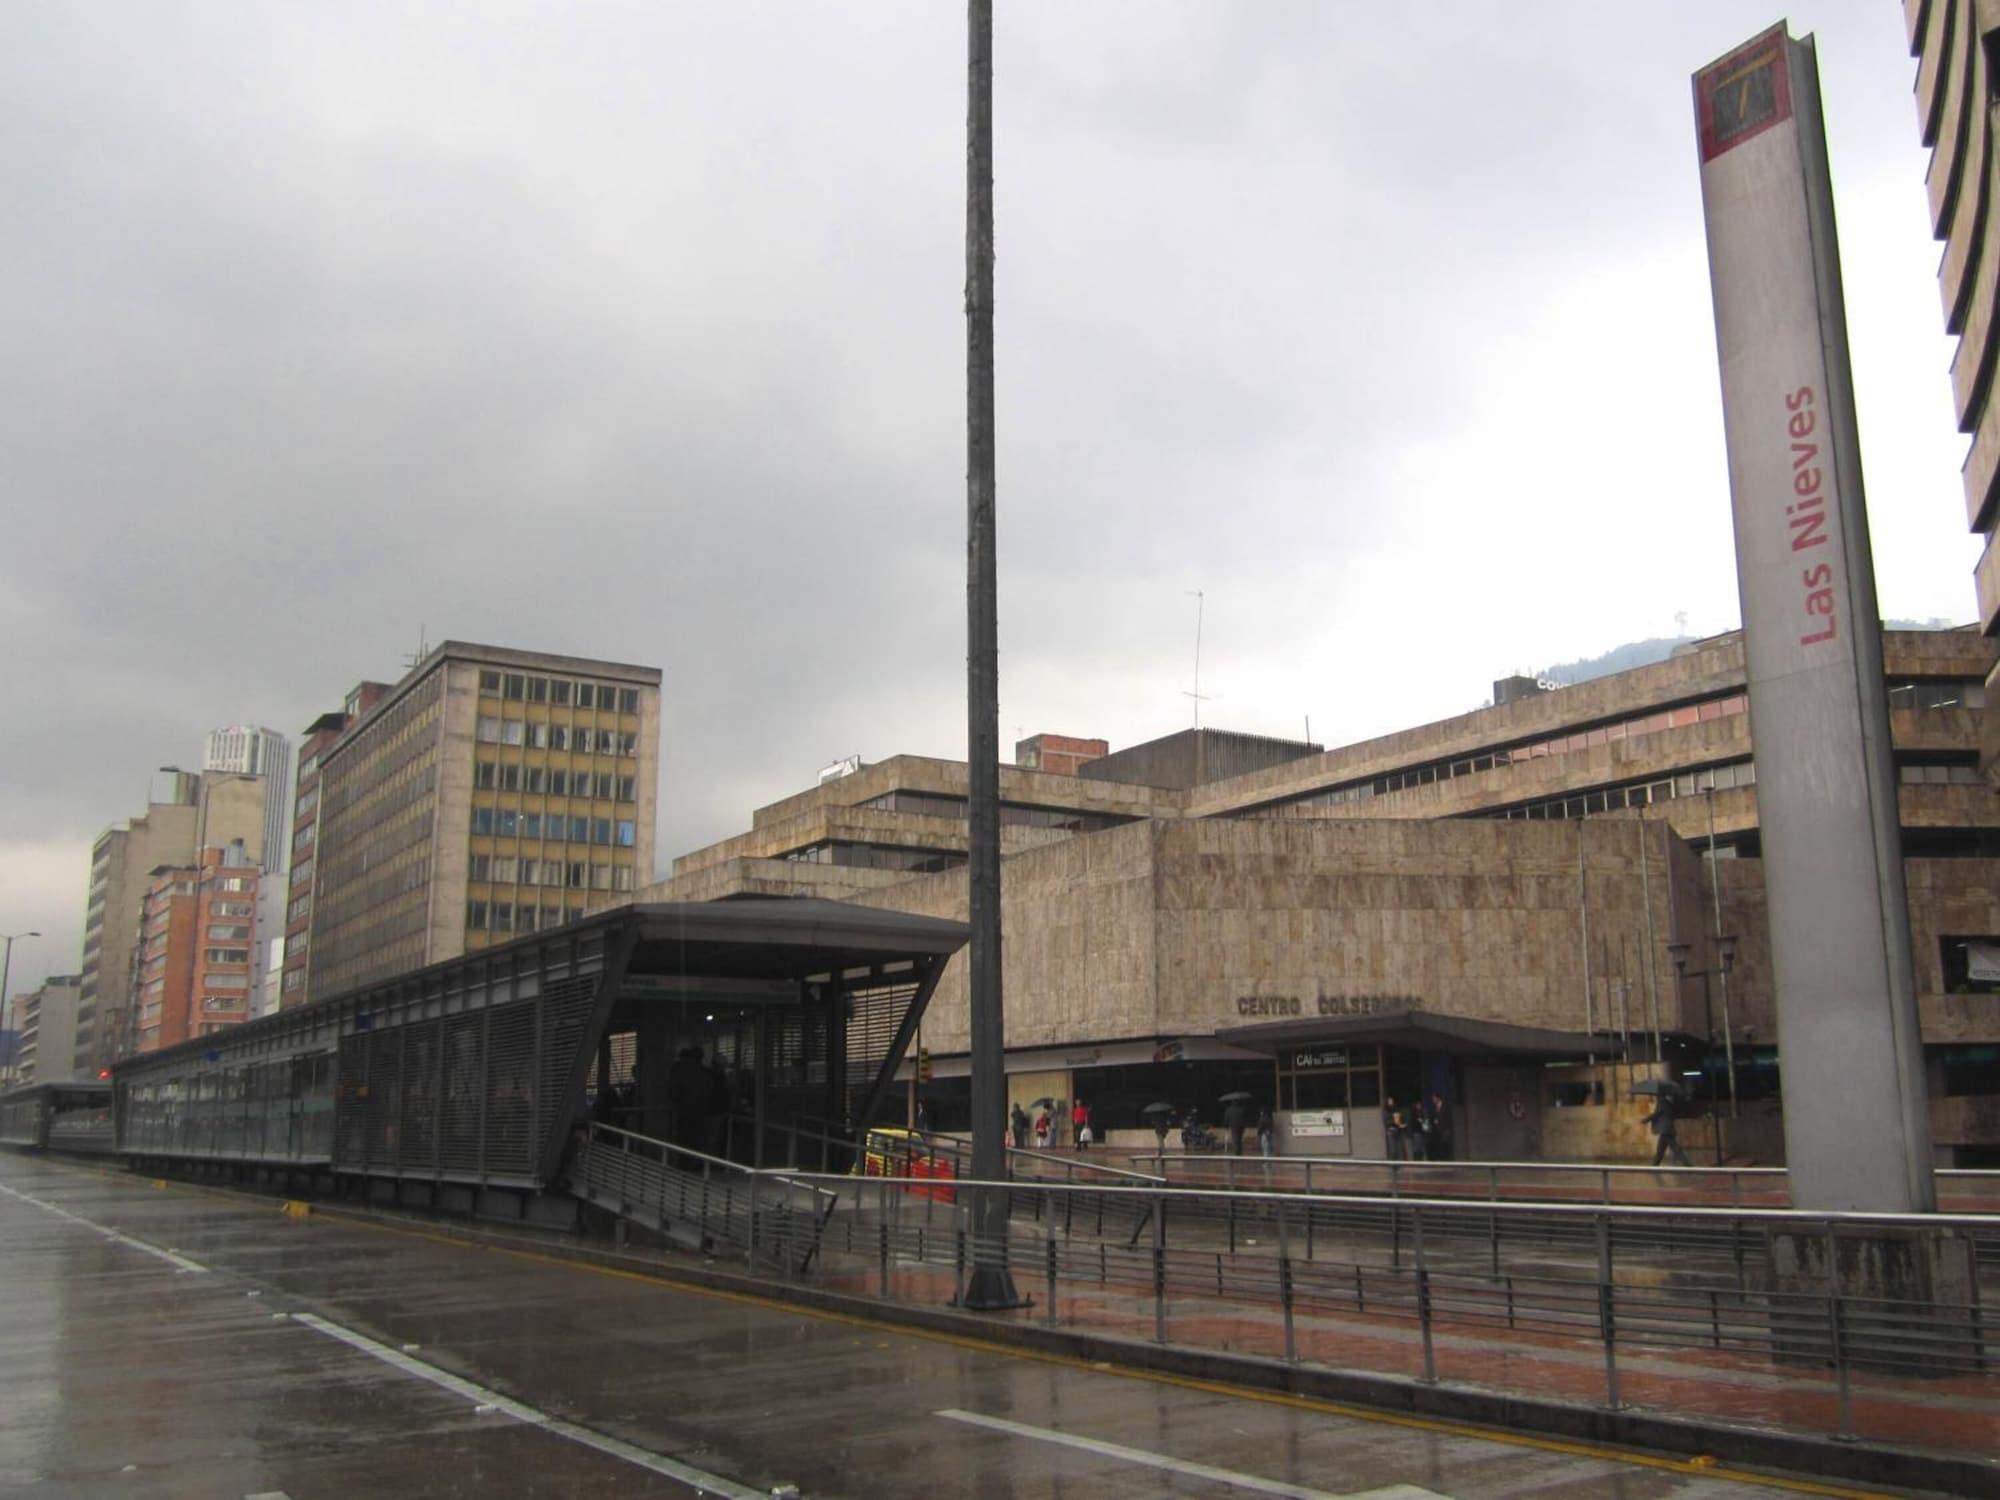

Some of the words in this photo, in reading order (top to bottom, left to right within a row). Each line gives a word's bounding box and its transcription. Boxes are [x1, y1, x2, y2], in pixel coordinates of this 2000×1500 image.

[1786, 385, 1828, 552] Nieves
[1801, 563, 1837, 646] Las
[1237, 995, 1302, 1015] CENTRO
